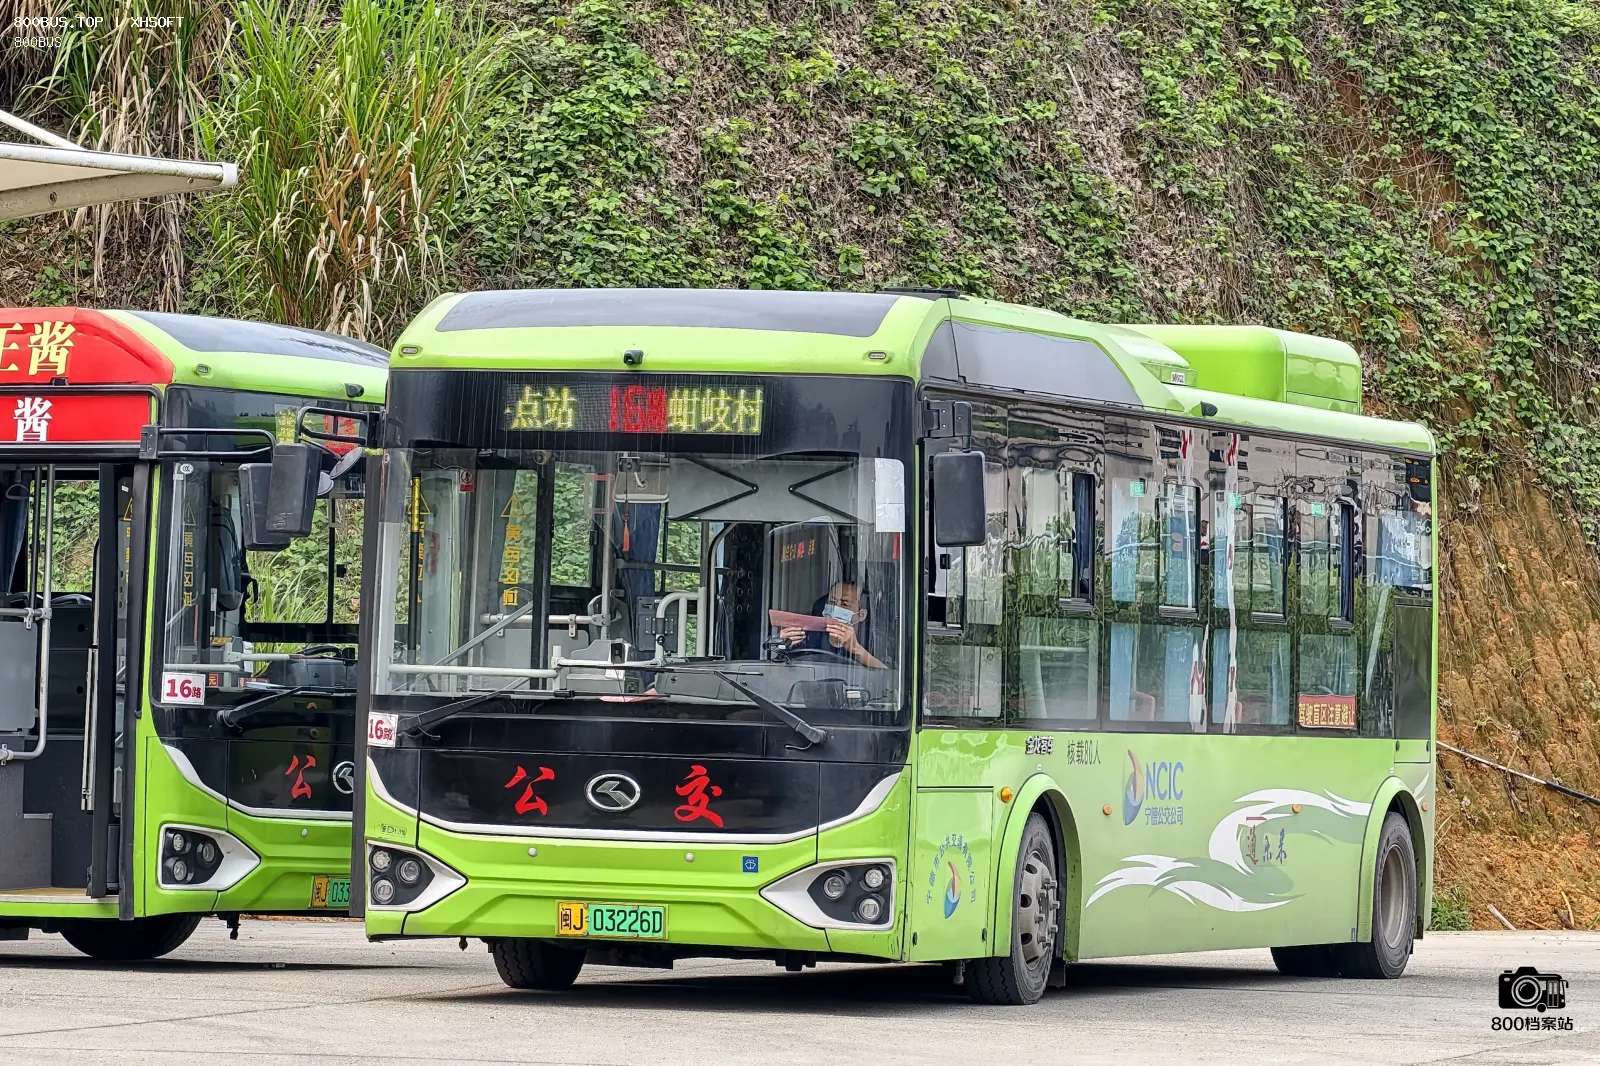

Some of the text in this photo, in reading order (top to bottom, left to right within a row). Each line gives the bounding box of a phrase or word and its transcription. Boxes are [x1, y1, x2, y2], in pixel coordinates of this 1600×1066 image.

[13, 396, 53, 442] 酱
[504, 384, 577, 431] 点站
[166, 678, 202, 699] 16路
[368, 718, 394, 741] 16路
[1066, 739, 1102, 766] 核载80人
[285, 755, 316, 800] 公
[1145, 761, 1185, 801] NCIC
